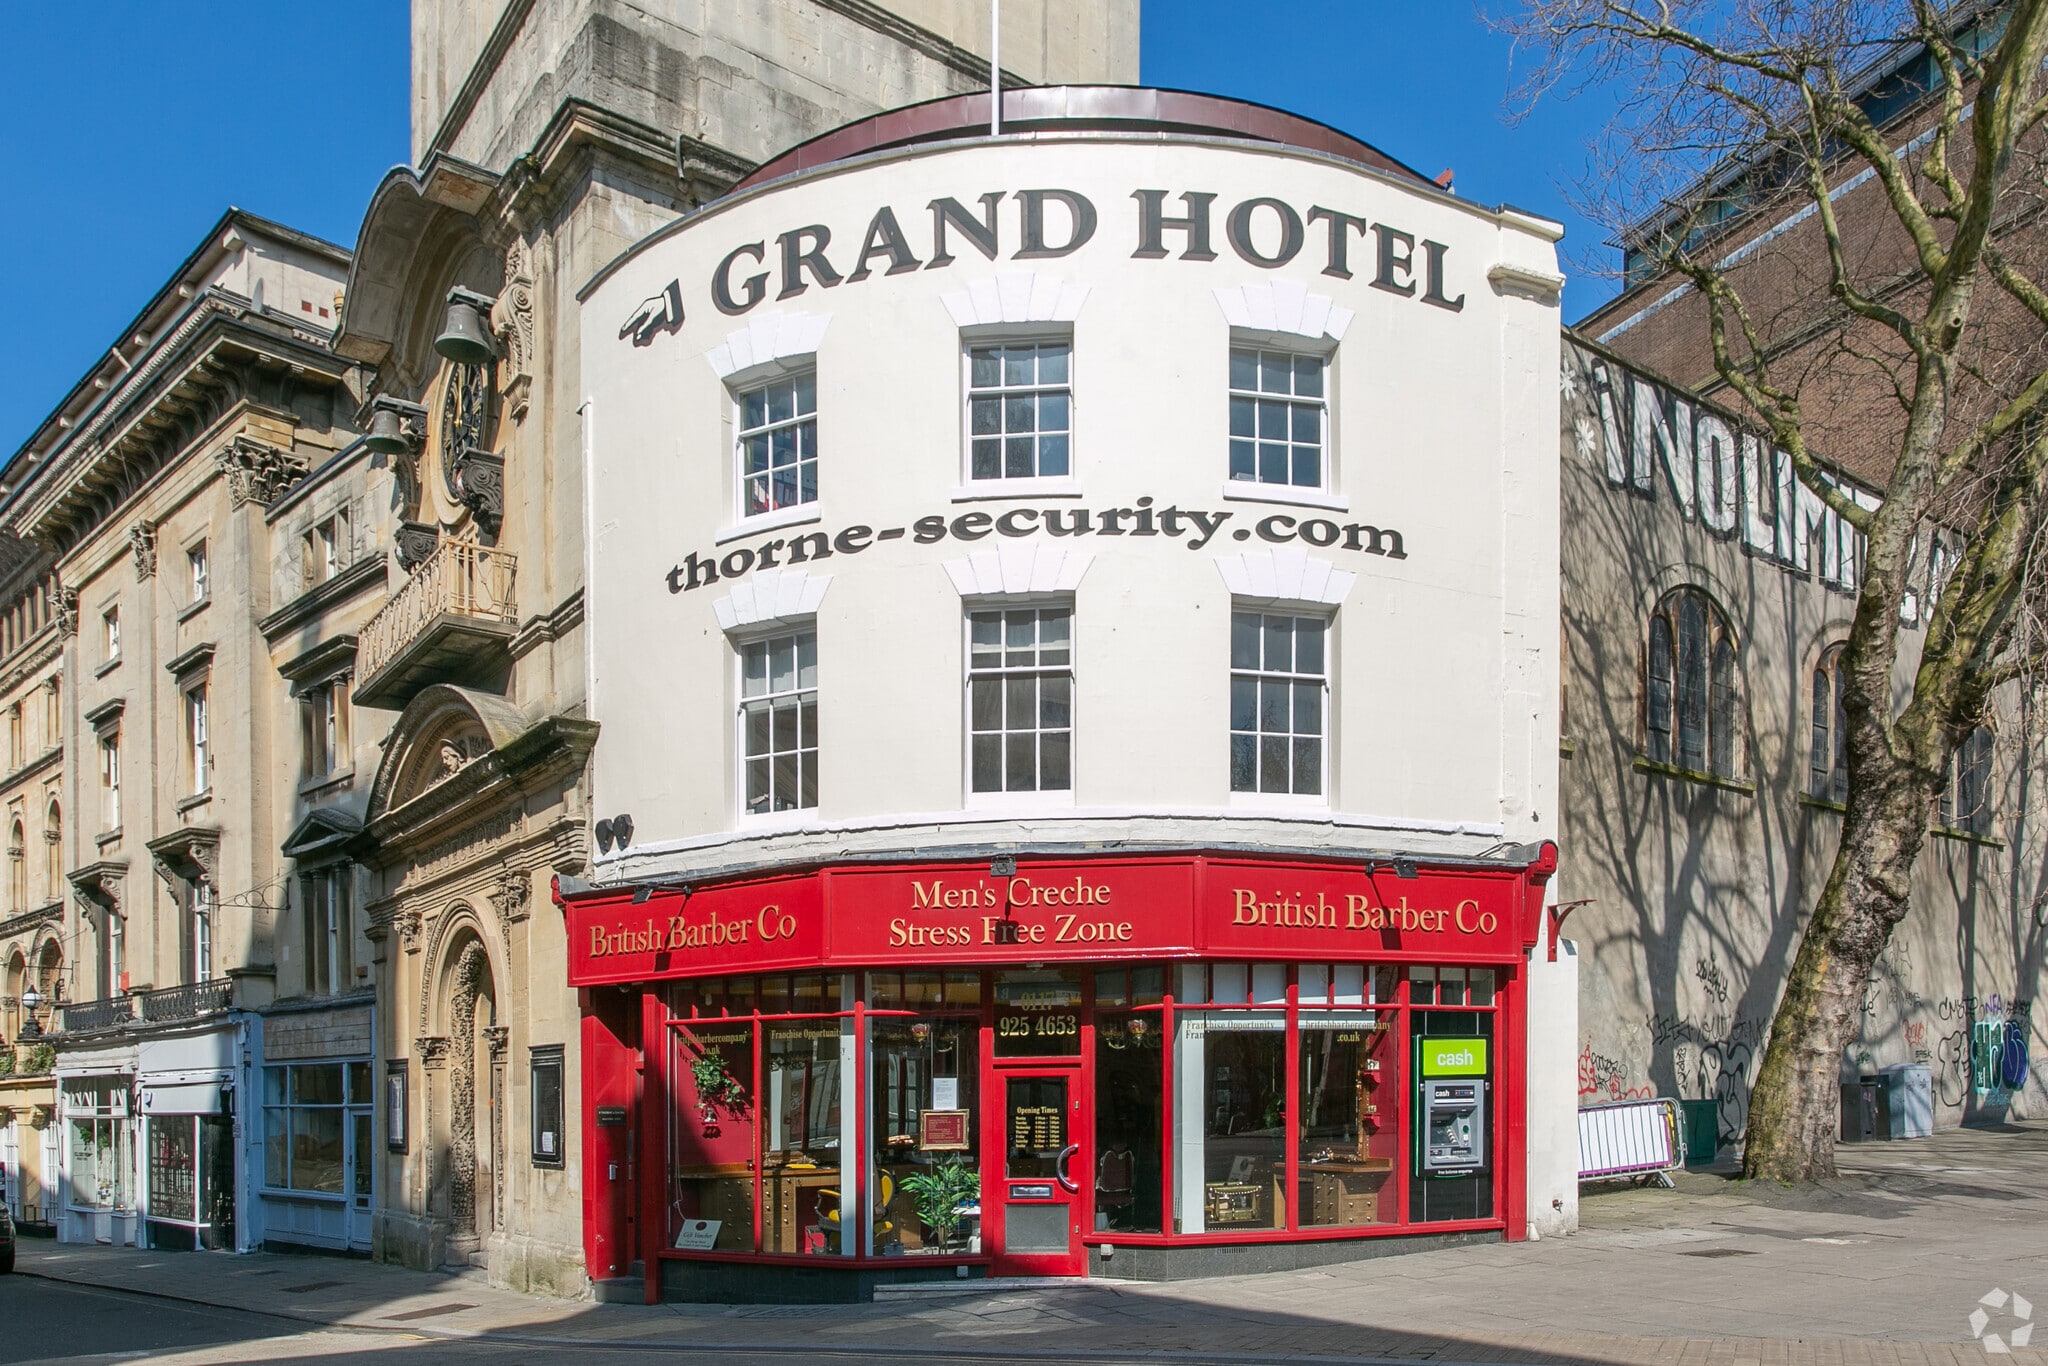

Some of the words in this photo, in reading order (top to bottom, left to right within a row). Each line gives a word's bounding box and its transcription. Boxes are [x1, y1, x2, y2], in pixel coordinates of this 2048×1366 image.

[711, 189, 1098, 317] GRAND
[1130, 188, 1466, 313] HOTEL
[663, 496, 1410, 595] thorne-security.com
[911, 879, 997, 909] Men's
[1008, 876, 1111, 907] Creche
[1231, 888, 1338, 928] British
[1344, 894, 1449, 933] Barber
[1455, 899, 1498, 934] Co
[589, 918, 662, 958] British
[668, 912, 752, 951] Barber
[757, 904, 797, 941] Co
[889, 917, 971, 947] Stress
[981, 915, 1046, 944] Free
[1055, 914, 1133, 943] Zone
[1021, 991, 1055, 1011] 0117
[771, 1029, 802, 1040] Franchise
[1000, 1016, 1030, 1036] 925
[1035, 1015, 1076, 1036] 4653
[1336, 1031, 1360, 1042] .co.uk
[1436, 1048, 1474, 1067] cash
[1435, 1089, 1450, 1098] cash
[1016, 1106, 1040, 1115] Opening
[1040, 1106, 1058, 1114] Times
